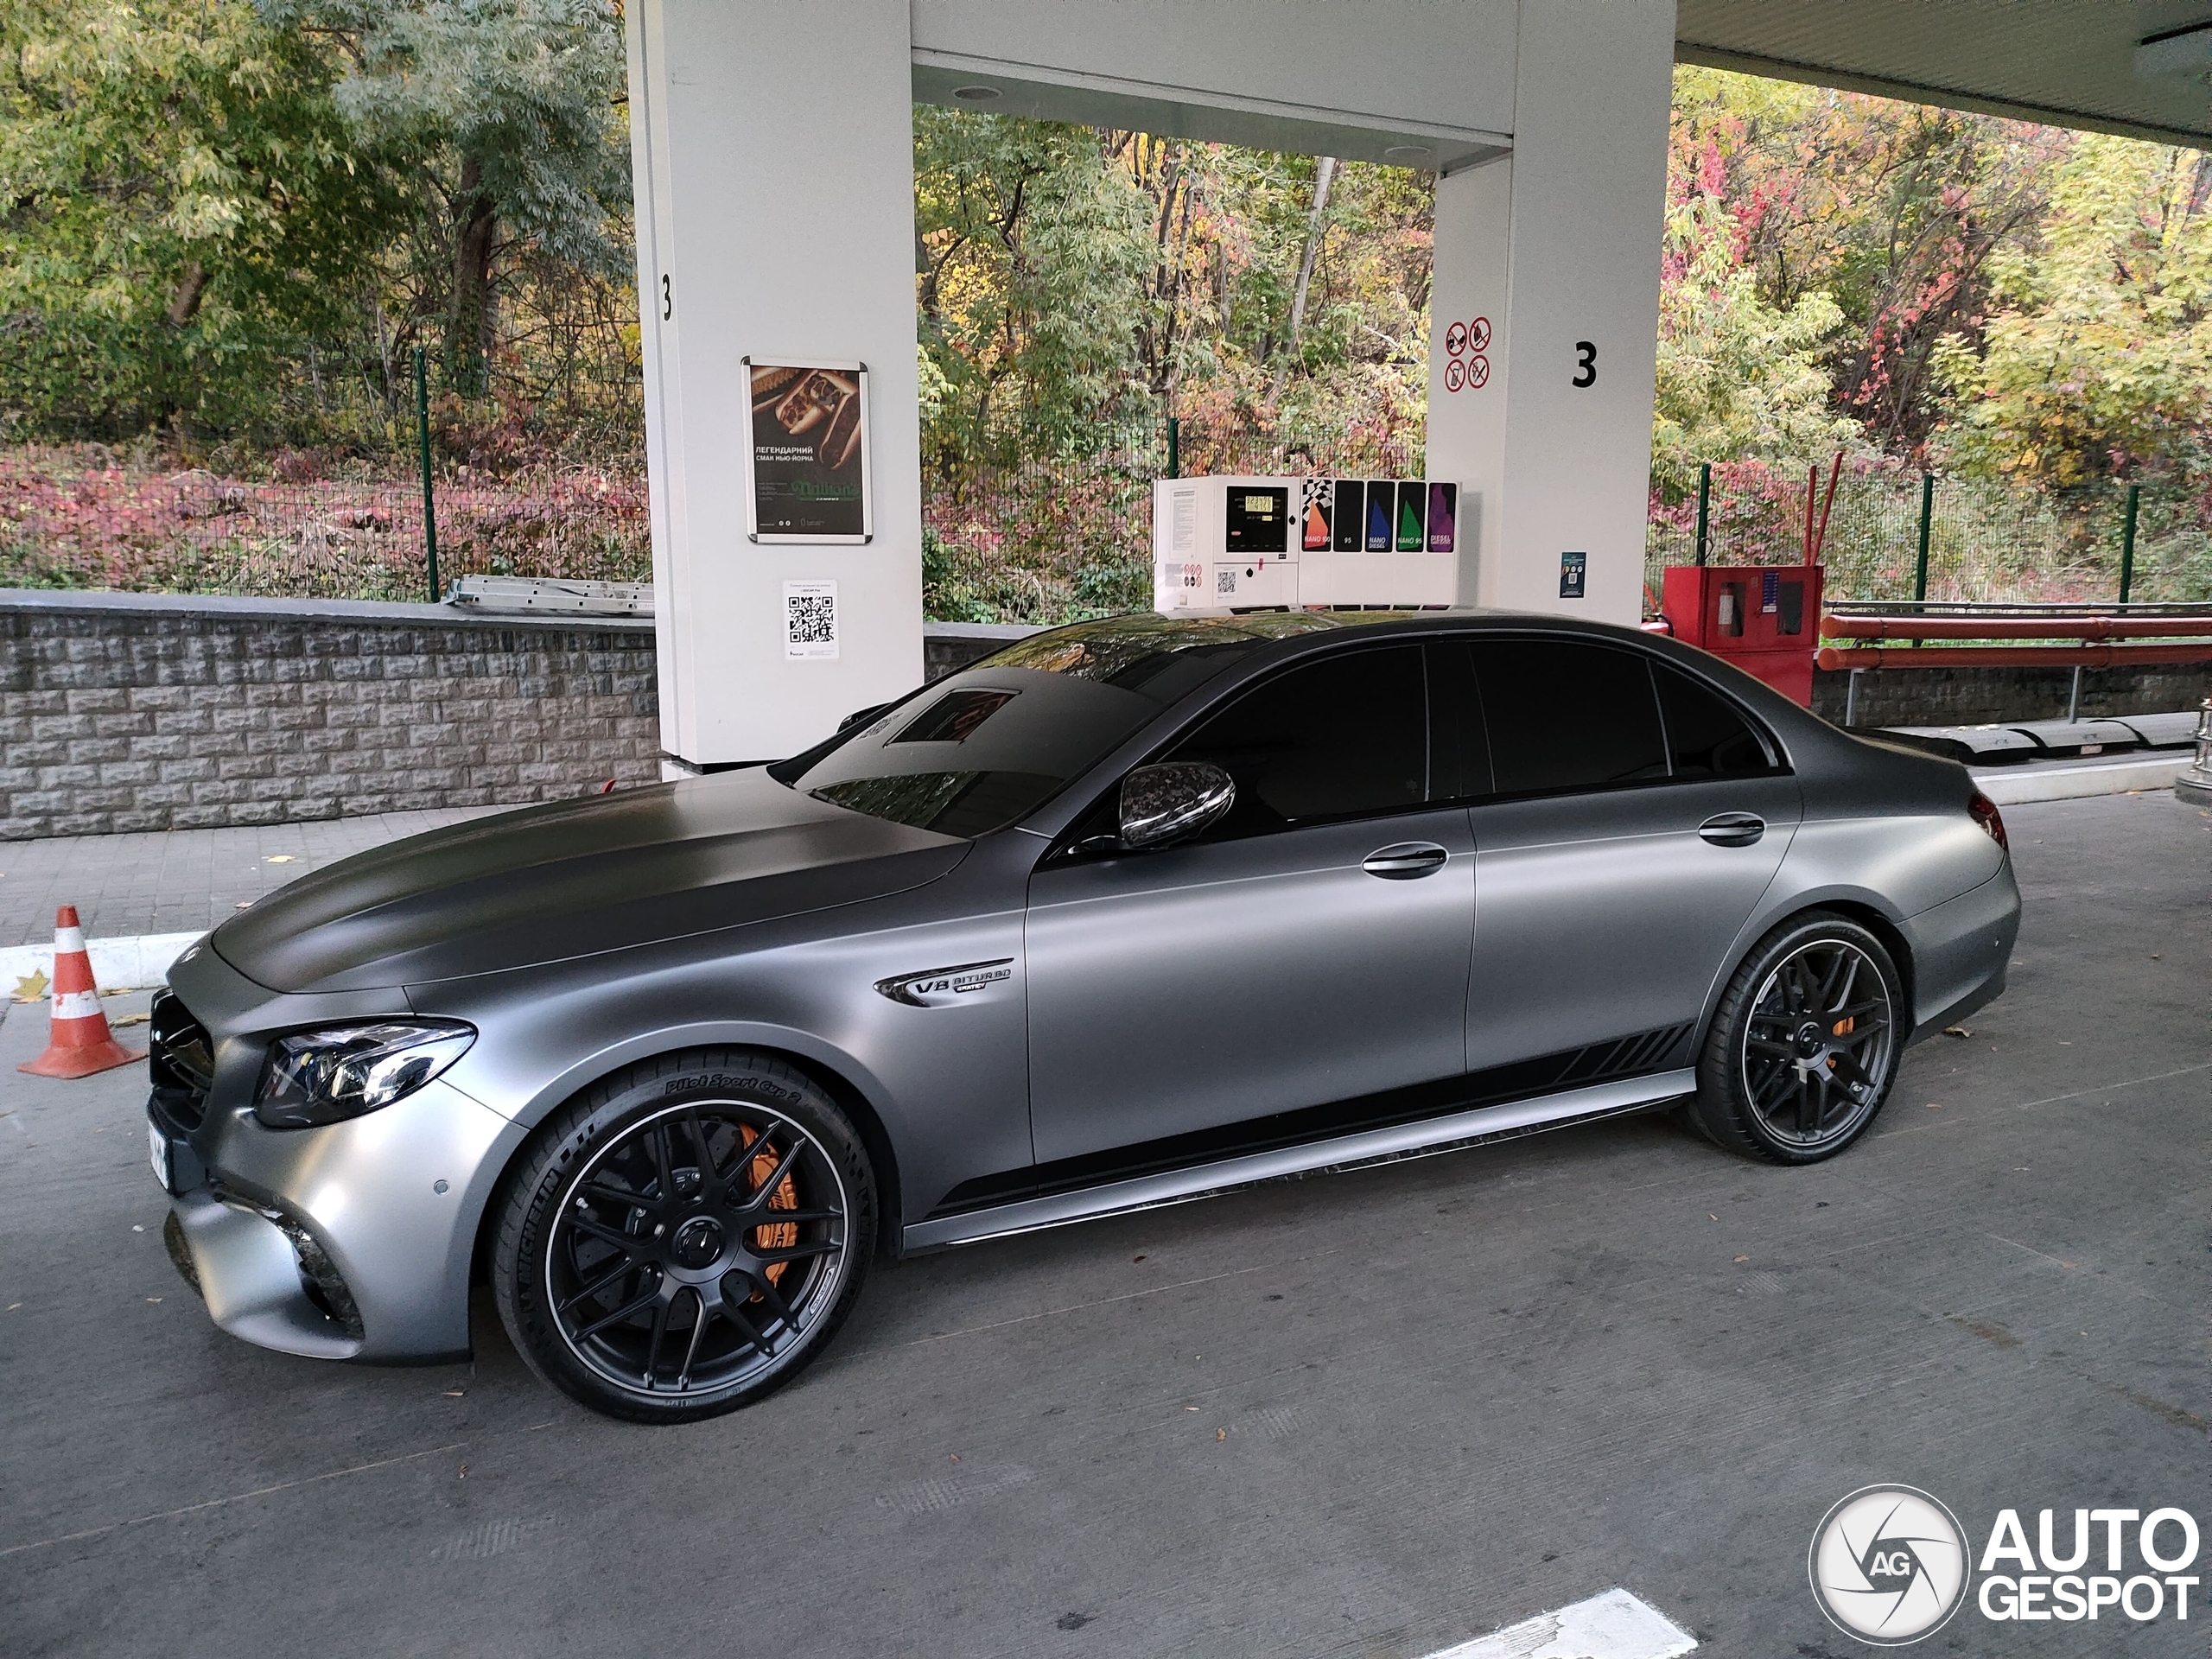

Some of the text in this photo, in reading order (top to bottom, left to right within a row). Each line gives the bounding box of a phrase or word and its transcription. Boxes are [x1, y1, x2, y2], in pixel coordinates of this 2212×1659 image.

[663, 273, 671, 321] 3
[1572, 341, 1597, 388] 3
[756, 446, 813, 454] ЛЕГЕНДАРНИЙ
[915, 969, 1011, 994] V8 BITURBO
[664, 1073, 802, 1103] Pilot Sport Cup 2
[518, 1168, 563, 1284] MICHELIN
